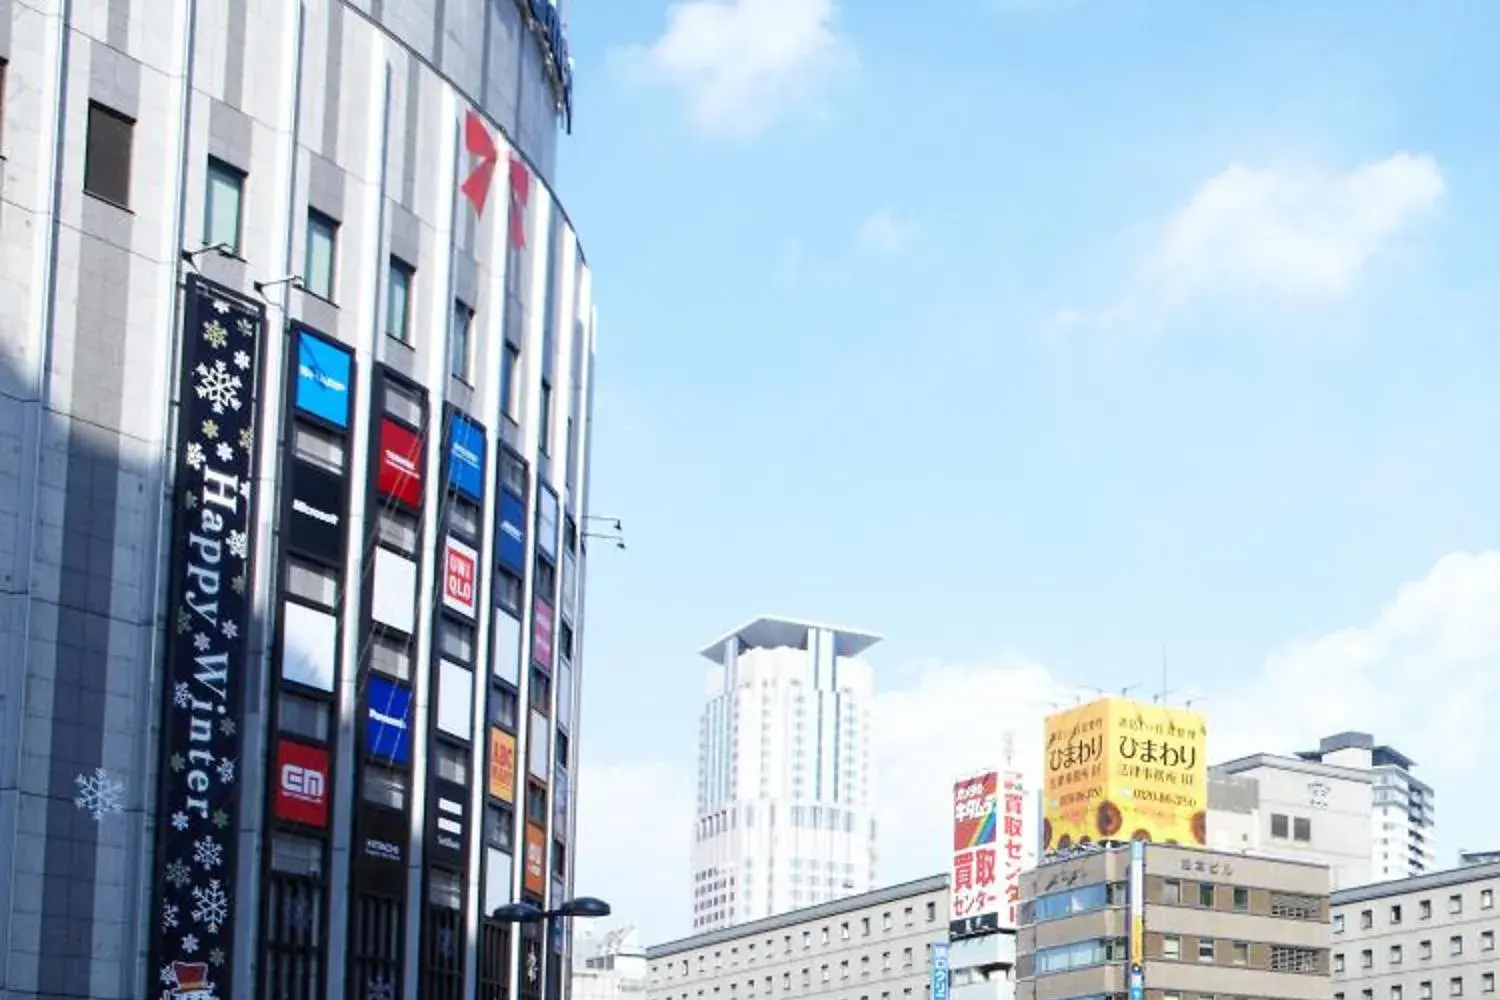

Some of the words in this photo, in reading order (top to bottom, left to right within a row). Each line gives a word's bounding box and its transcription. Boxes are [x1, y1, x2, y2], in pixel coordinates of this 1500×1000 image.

[186, 465, 239, 628] Happy
[186, 651, 229, 820] Winter
[1050, 735, 1103, 771] ひまわり
[1119, 735, 1197, 770] ひまわり
[954, 848, 997, 892] 買取
[1003, 793, 1023, 924] 買取センター
[954, 890, 998, 916] センター
